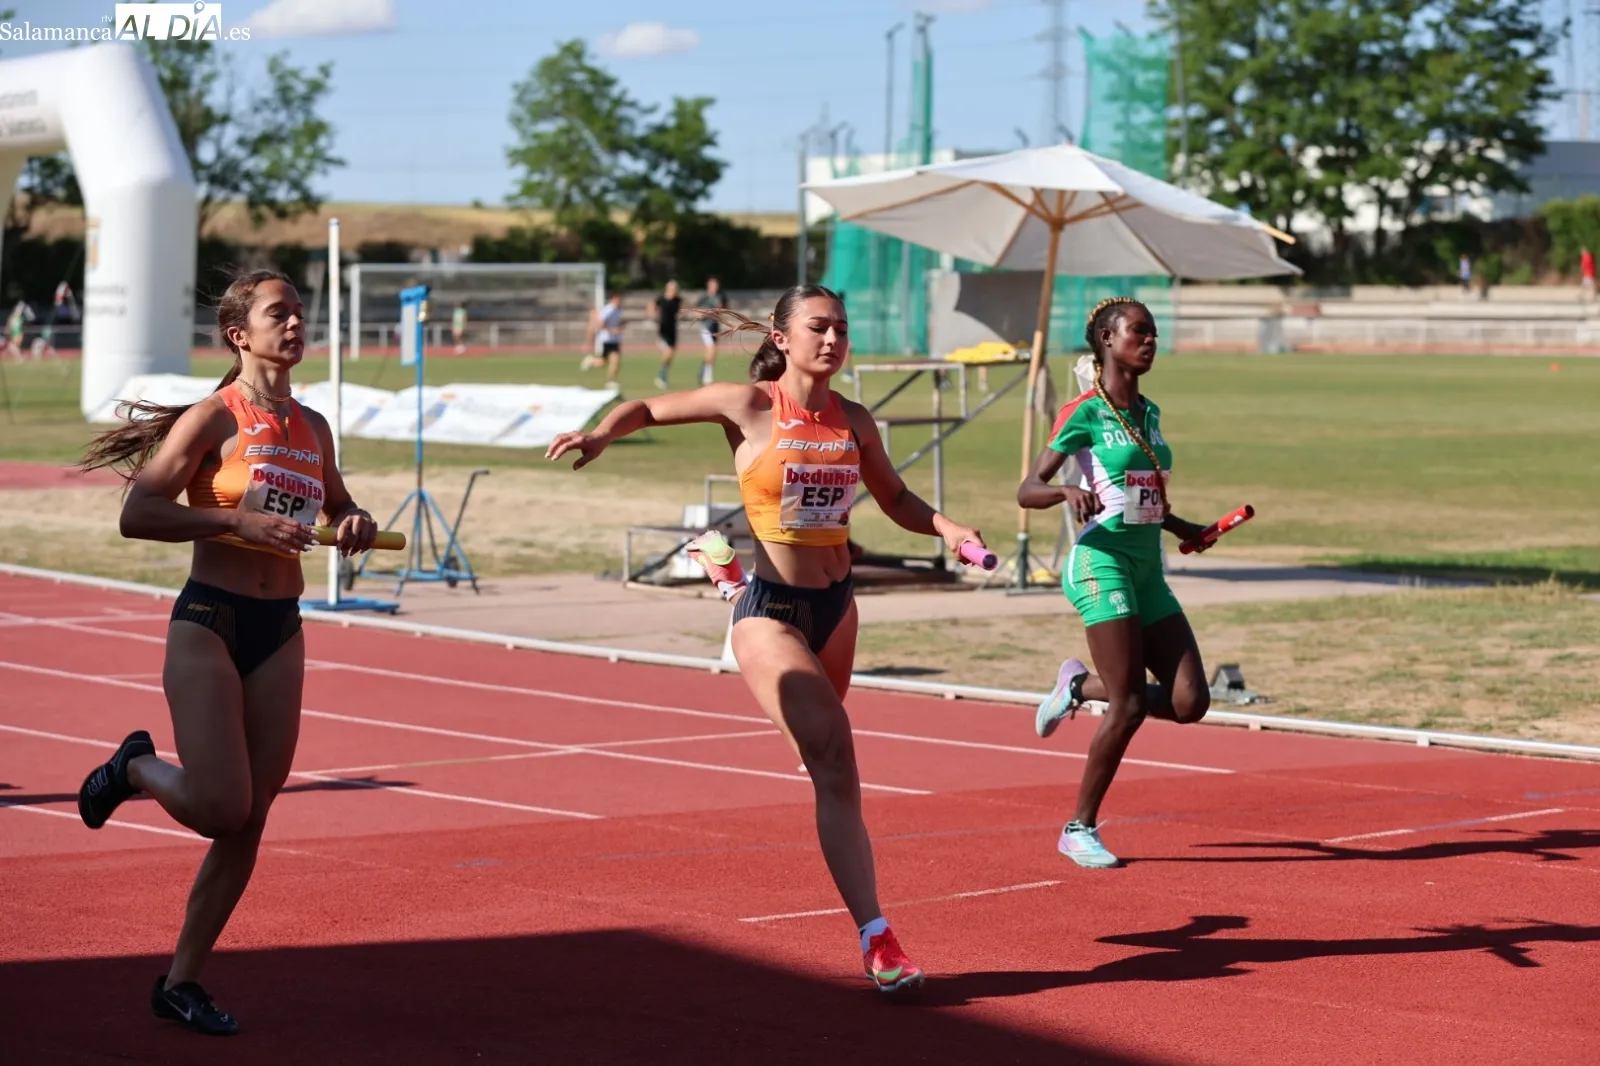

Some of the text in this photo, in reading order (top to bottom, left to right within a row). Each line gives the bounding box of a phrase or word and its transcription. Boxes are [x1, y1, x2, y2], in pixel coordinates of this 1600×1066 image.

[776, 438, 856, 452] ESPAÑA
[244, 445, 320, 466] ESPAÑA
[786, 468, 858, 486] bedunia
[263, 487, 305, 519] ESP
[801, 487, 844, 507] ESP
